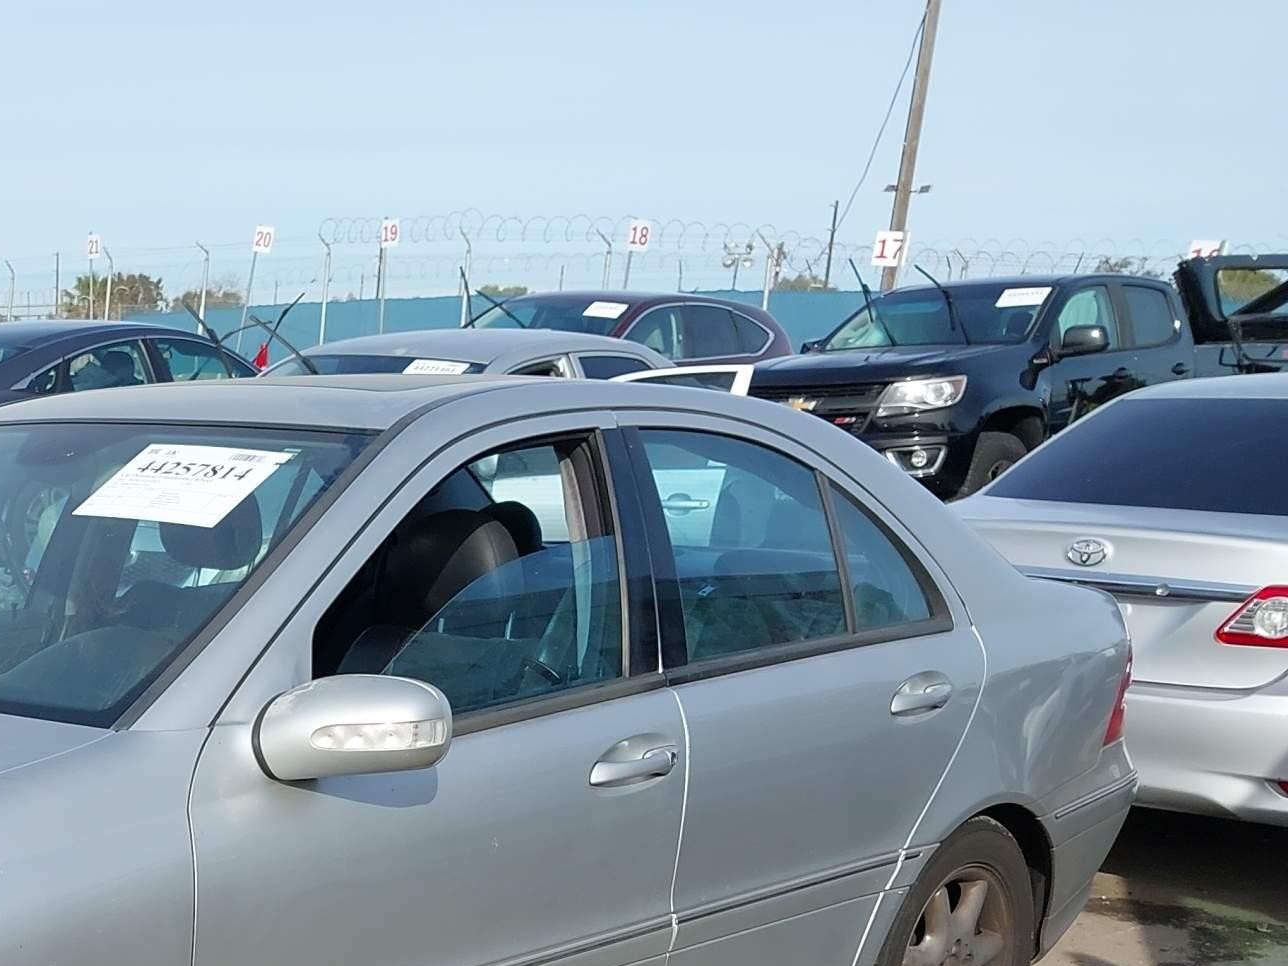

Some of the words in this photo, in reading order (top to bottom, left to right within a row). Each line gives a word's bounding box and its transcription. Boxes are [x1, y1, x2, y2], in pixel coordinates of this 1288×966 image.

[255, 231, 272, 248] 20
[383, 224, 398, 242] 19
[629, 226, 649, 246] 18
[88, 240, 99, 254] 21
[874, 239, 905, 260] 17
[137, 460, 254, 481] 44257814
